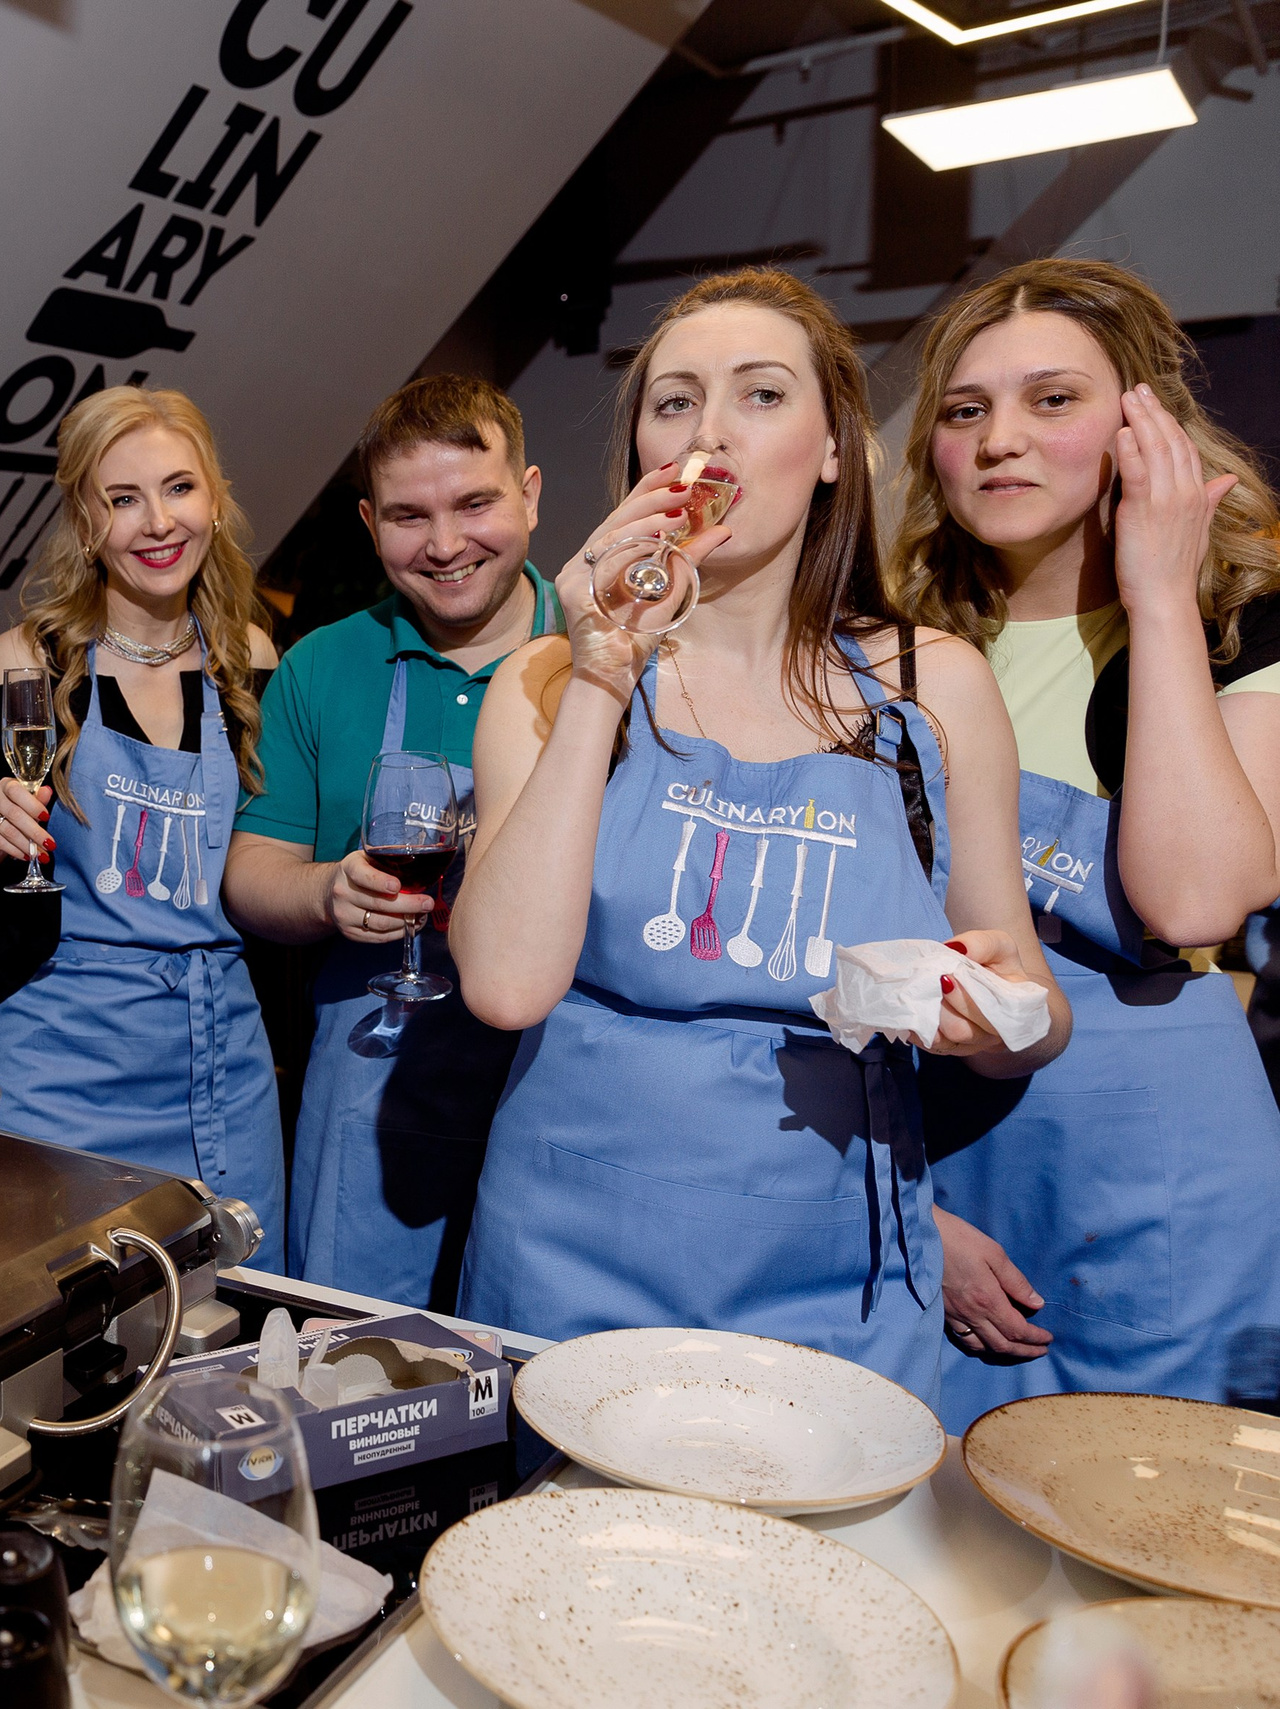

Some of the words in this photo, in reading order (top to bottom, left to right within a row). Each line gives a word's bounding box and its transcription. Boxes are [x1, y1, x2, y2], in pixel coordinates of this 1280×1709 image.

[128, 84, 322, 228] LIN
[63, 203, 256, 307] ARY
[107, 773, 184, 806] CULINAR
[331, 1398, 438, 1440] ПЕРЧАТКИ
[472, 1406, 486, 1417] 100
[349, 1425, 420, 1451] ВИНИЛОВЫЕ
[357, 1443, 412, 1462] НЕОПУДРЕННЫЕ
